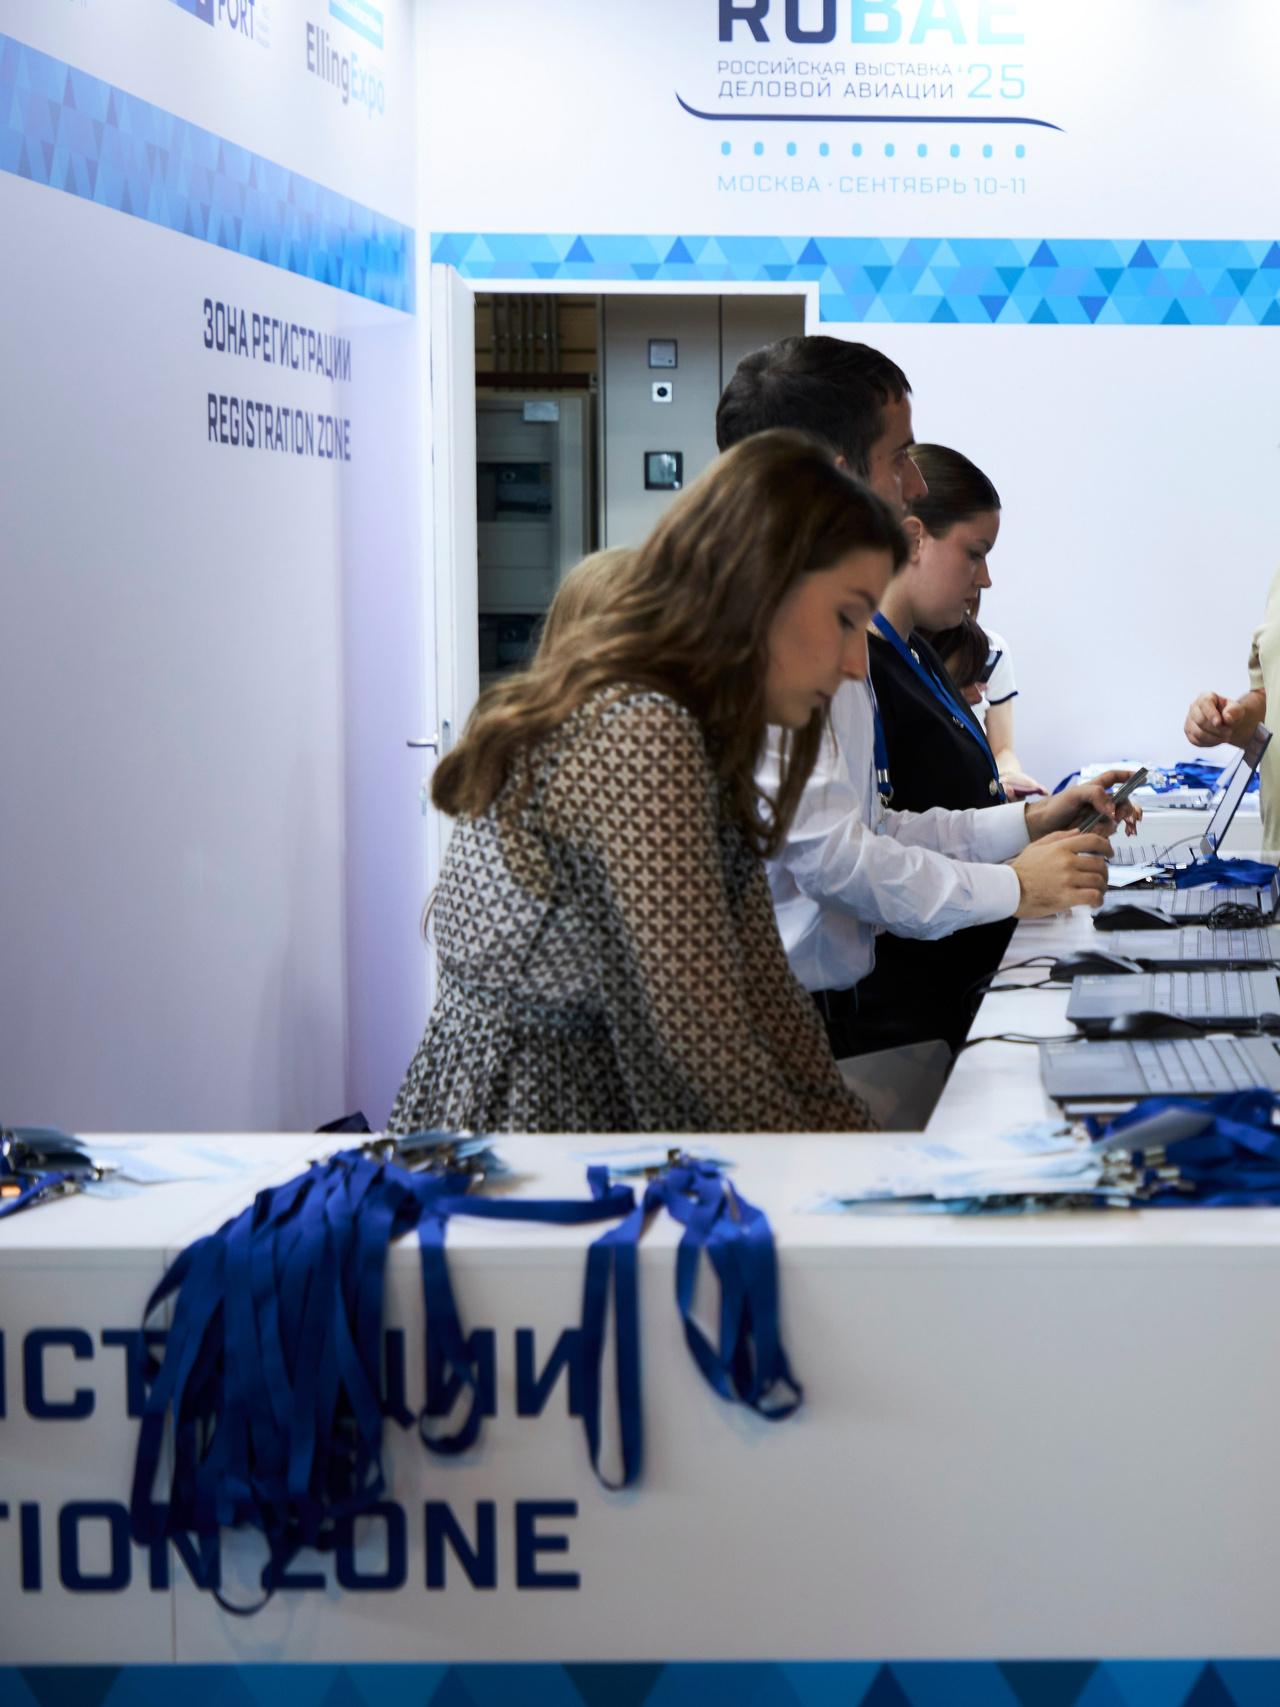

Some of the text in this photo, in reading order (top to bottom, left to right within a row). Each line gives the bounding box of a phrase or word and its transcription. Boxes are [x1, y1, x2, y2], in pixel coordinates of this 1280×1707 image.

[306, 22, 385, 119] EllingExpo
[718, 57, 953, 77] РОССИЙСКАЯ ВЫСТАВКА
[718, 77, 954, 100] ДЕЛОВОЙ АВИАЦИИ
[717, 175, 1027, 195] МОСКВА СЕНТЯБРЬ 10-11
[203, 298, 352, 383] ЗОНА РЕГИСТРАЦИИ
[207, 392, 351, 461] REGISTRATION ZONE
